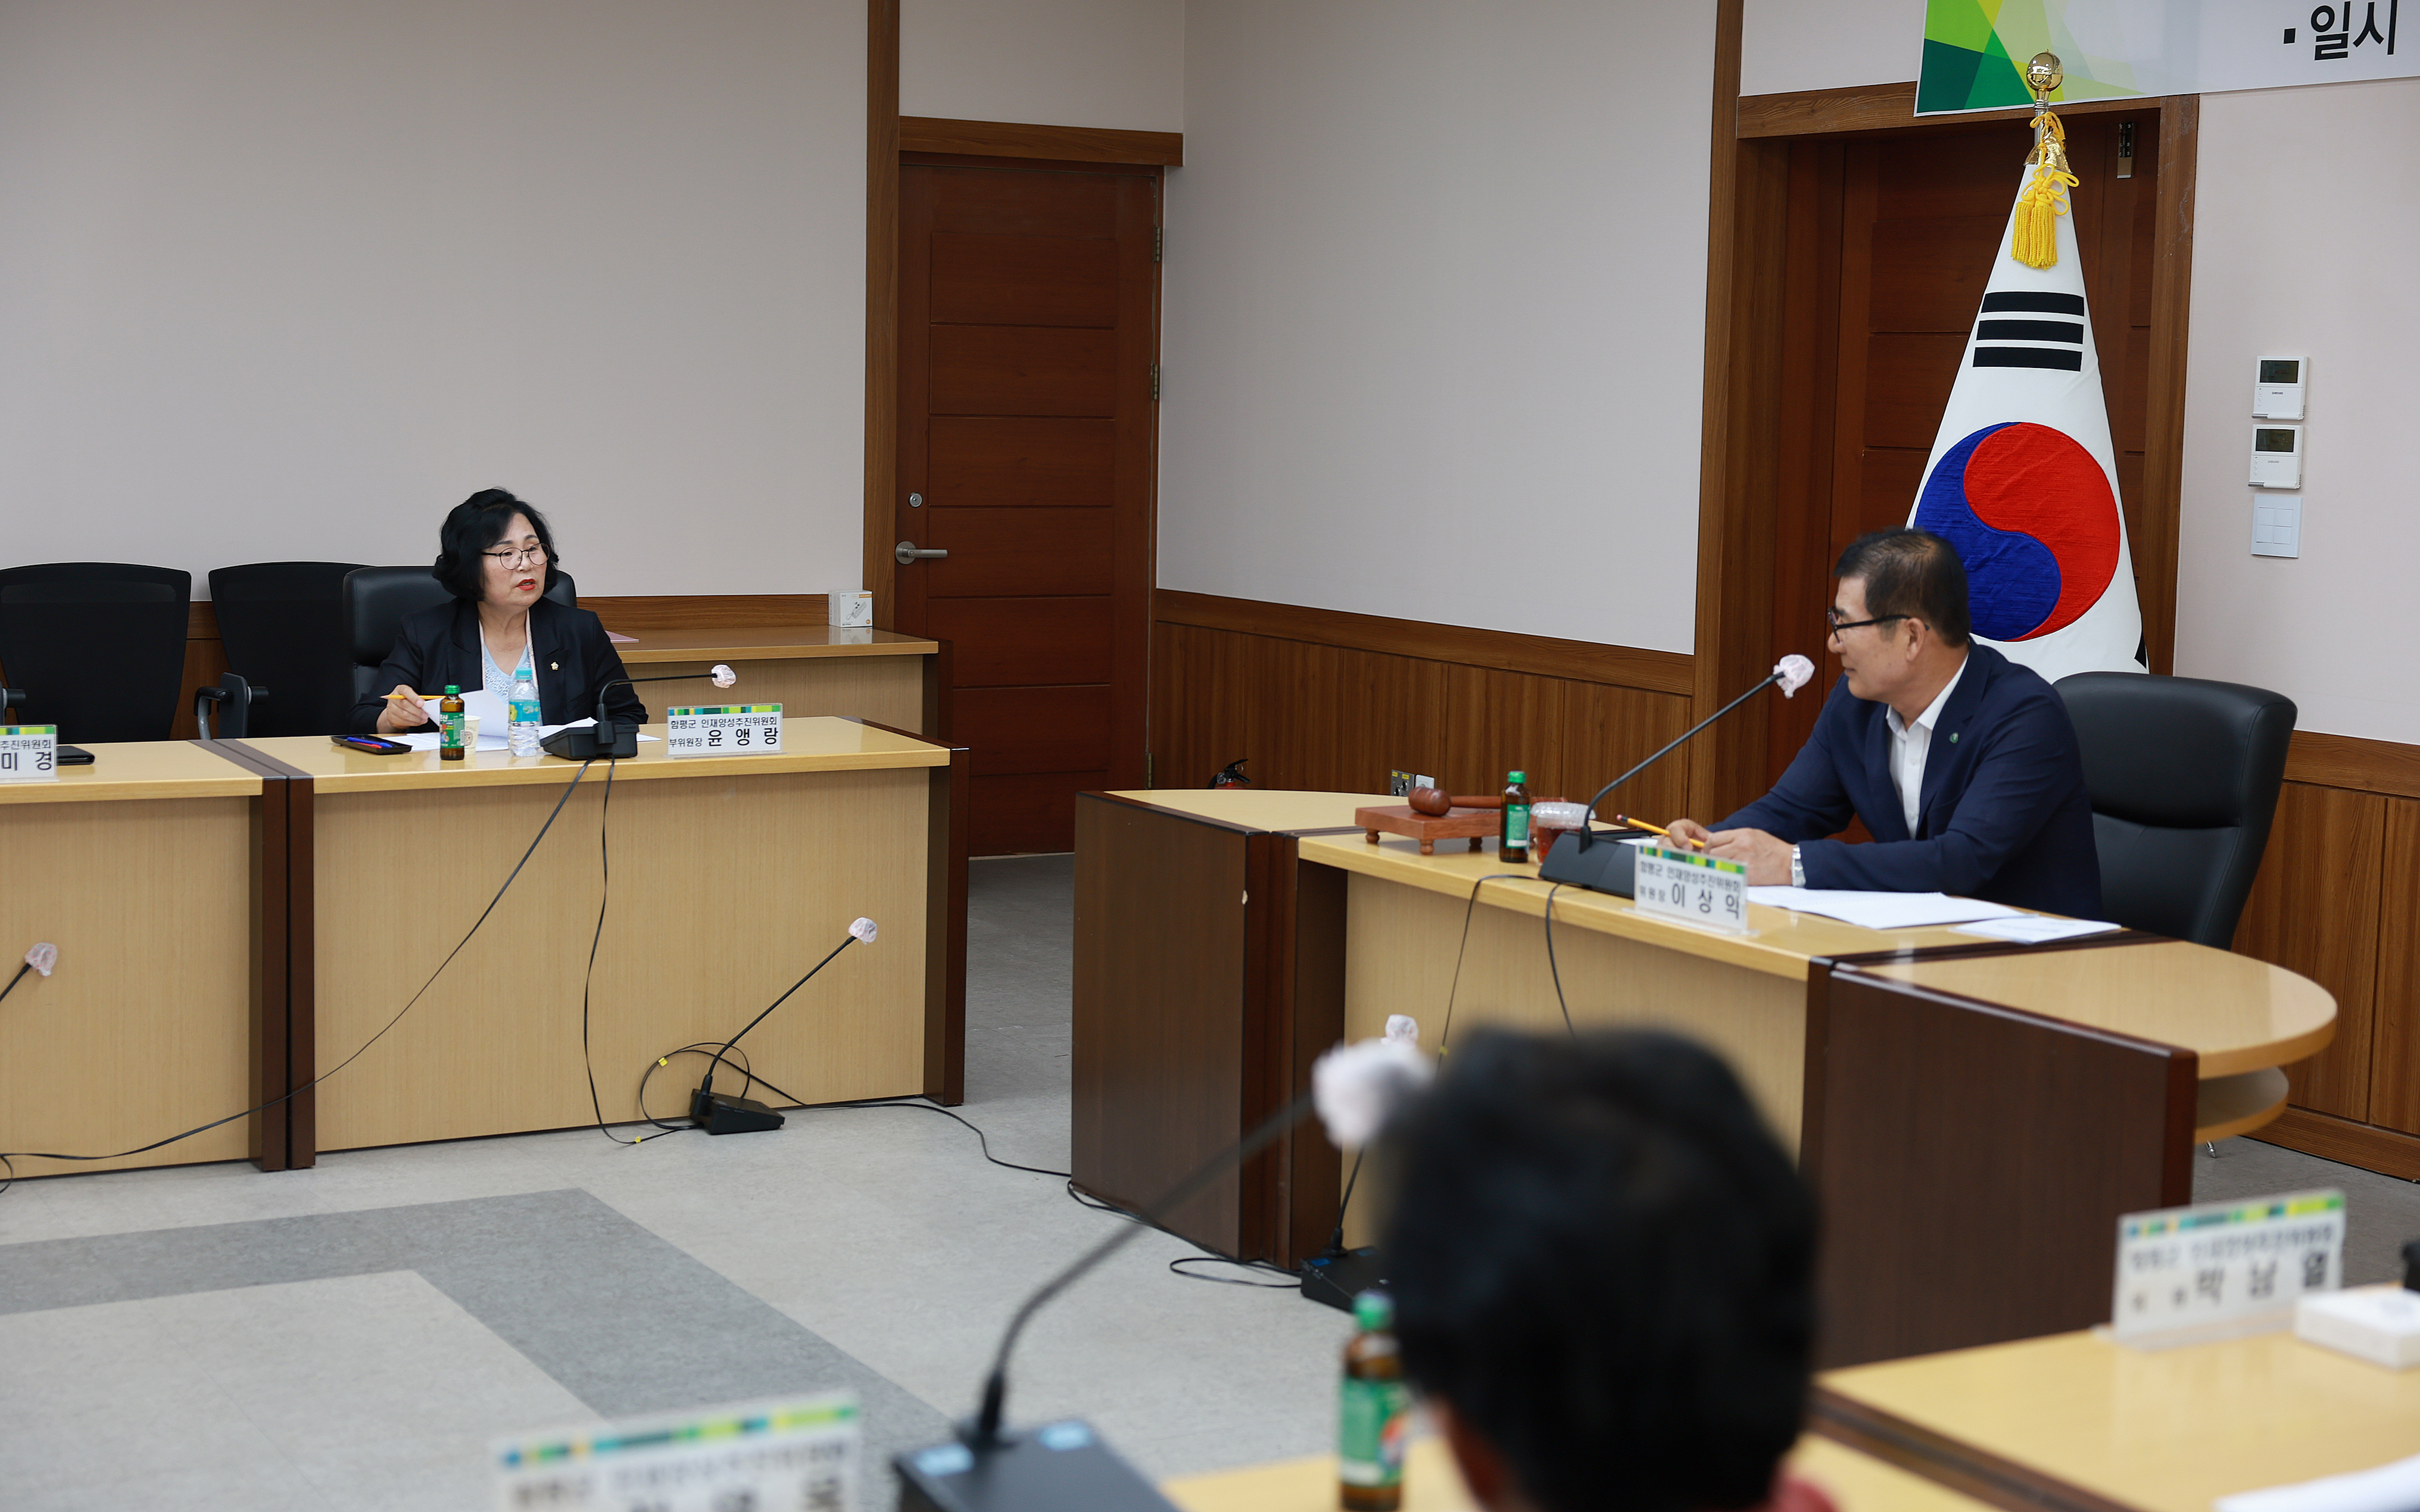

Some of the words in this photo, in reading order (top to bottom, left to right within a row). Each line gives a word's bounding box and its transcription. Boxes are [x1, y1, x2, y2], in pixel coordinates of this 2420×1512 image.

[2310, 0, 2397, 61] 일시
[671, 720, 696, 729] 함평군
[701, 717, 777, 728] 인재양성추진위원회
[669, 738, 703, 747] 부위원장
